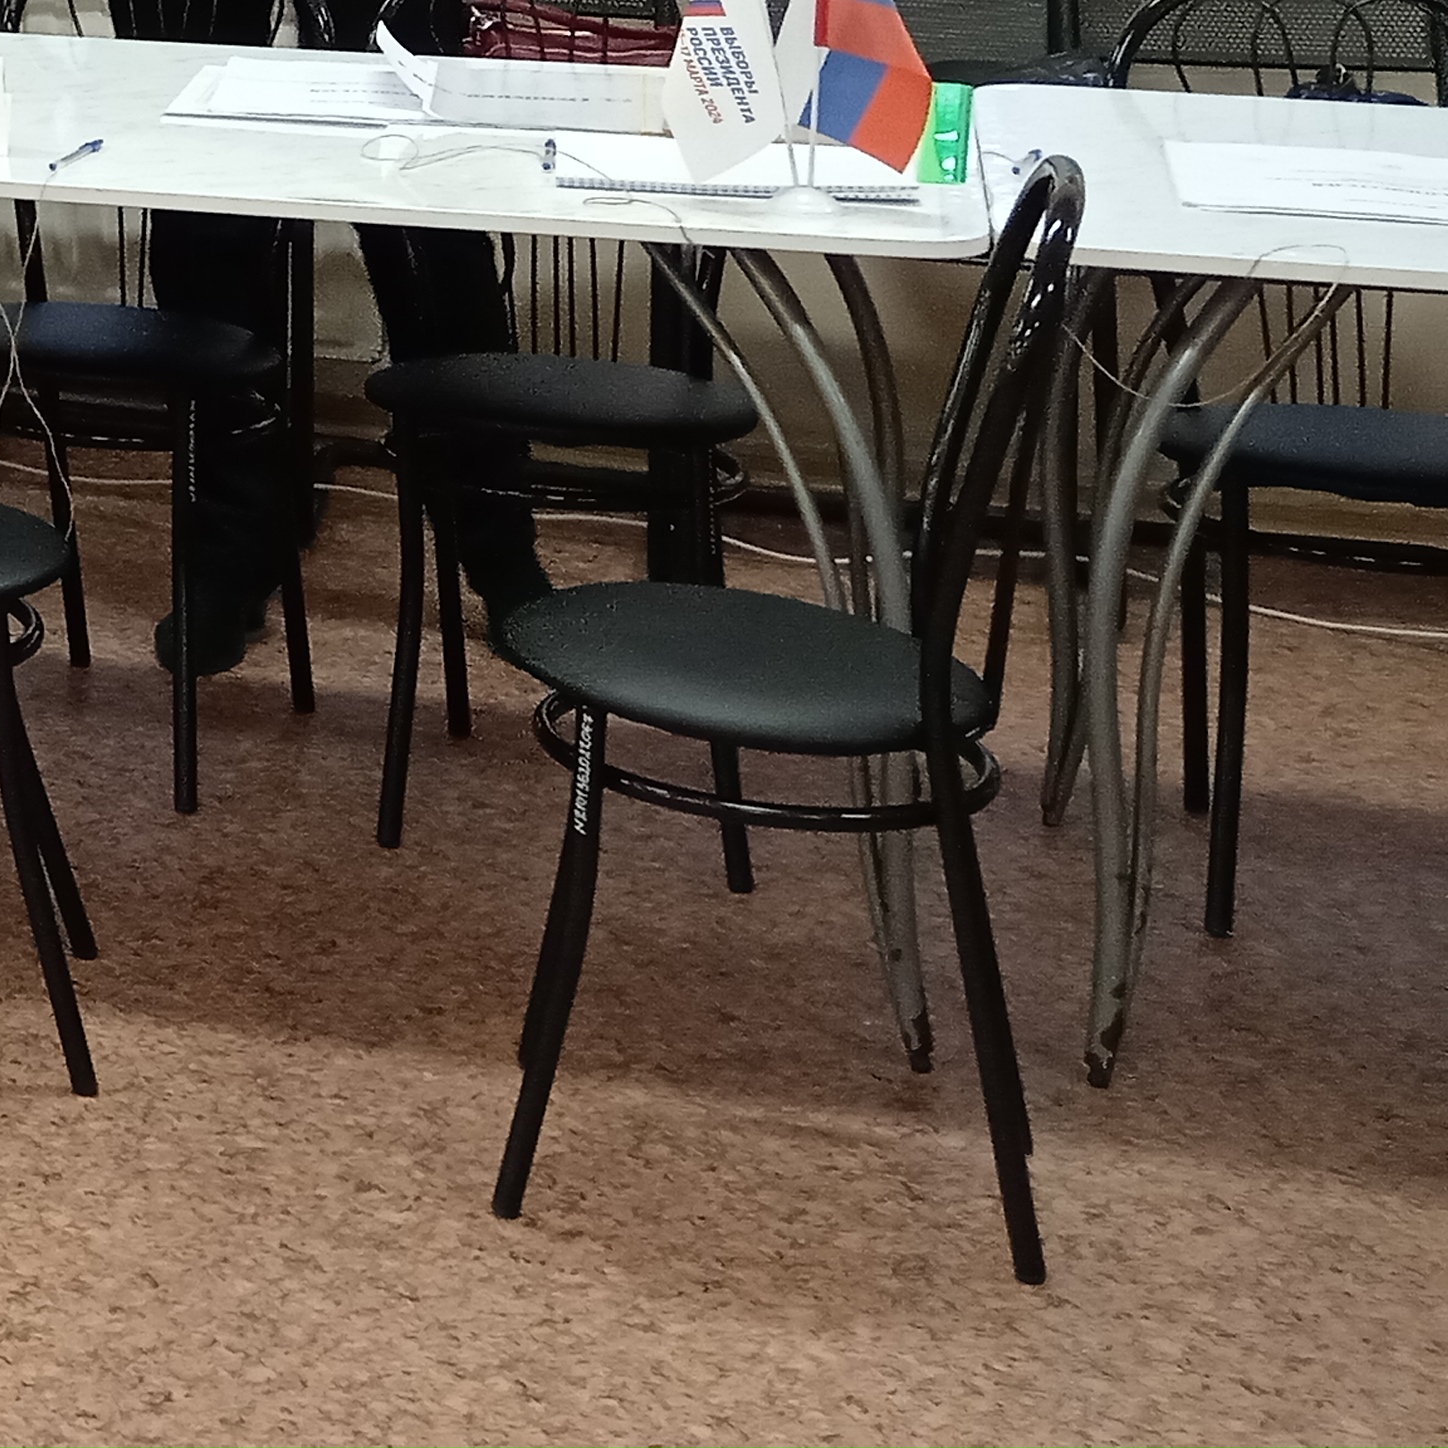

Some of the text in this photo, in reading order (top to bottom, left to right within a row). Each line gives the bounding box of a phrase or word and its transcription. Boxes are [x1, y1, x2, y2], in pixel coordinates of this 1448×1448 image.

[683, 58, 710, 97] МАРТА
[686, 27, 724, 88] РОССИИ
[701, 26, 756, 124] ПРЕЗИДЕНТА
[719, 26, 760, 94] ВЫБОРЫ
